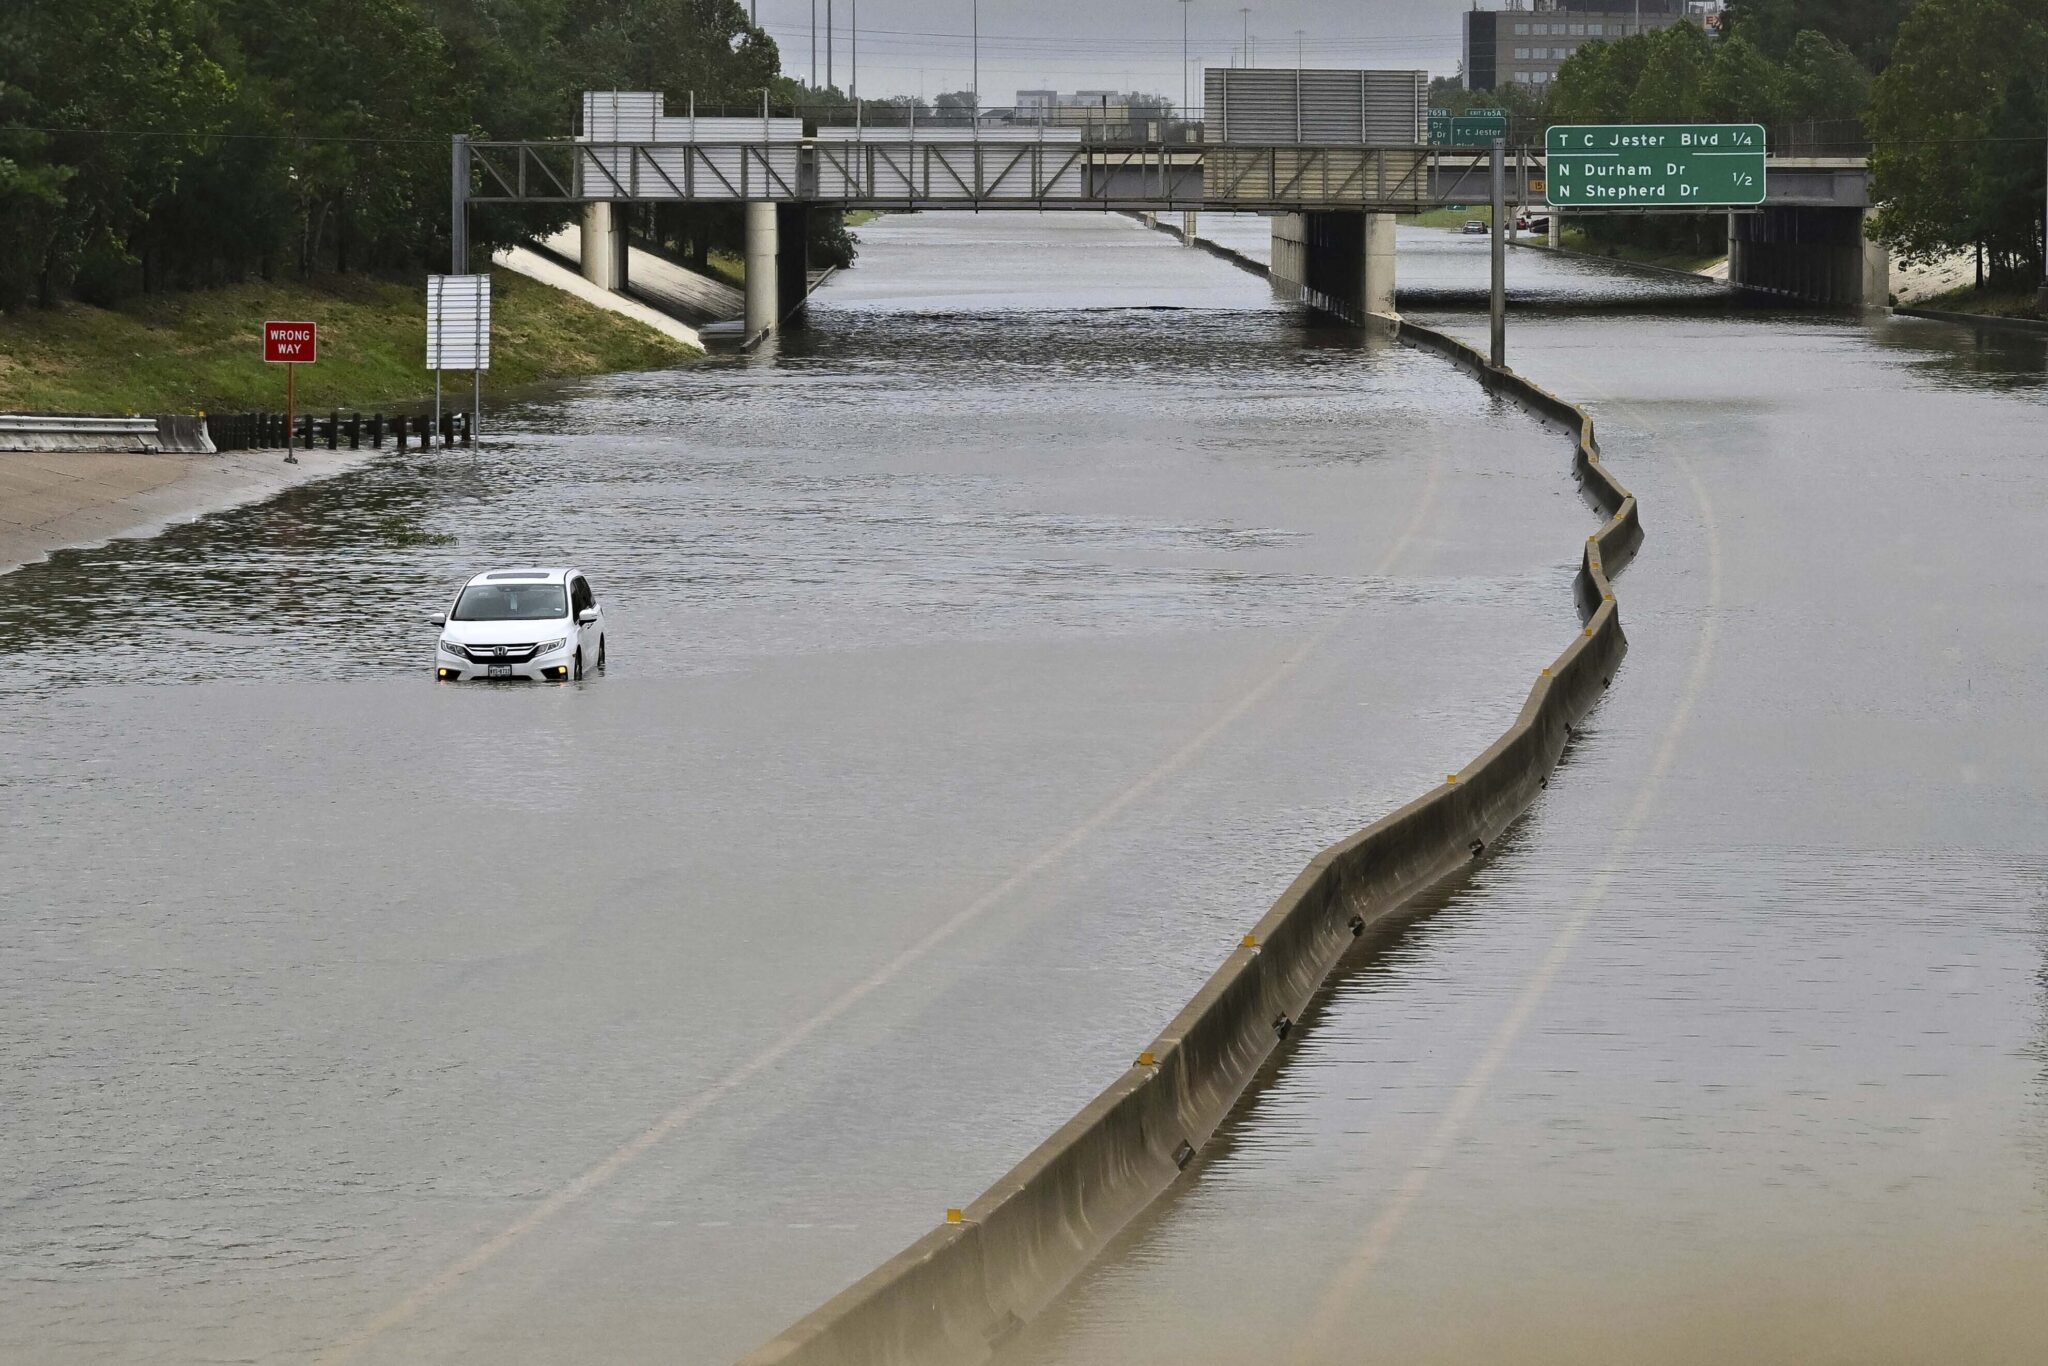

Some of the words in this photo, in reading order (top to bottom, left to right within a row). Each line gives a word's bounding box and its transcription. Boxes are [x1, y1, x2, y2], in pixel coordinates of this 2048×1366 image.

[1559, 134, 1568, 147] T
[1584, 134, 1594, 147] C
[1609, 133, 1665, 147] Jester
[1681, 133, 1719, 146] Blvd
[1732, 132, 1752, 146] 1/4
[1559, 164, 1570, 176] N
[1585, 163, 1652, 176] Durham
[1666, 163, 1686, 175] Dr
[1732, 172, 1753, 186] 1/2
[1559, 185, 1570, 197] N
[1586, 184, 1666, 199] Shepherd
[1680, 184, 1699, 196] Dr
[270, 330, 310, 341] WRONG
[278, 344, 302, 354] WAY
